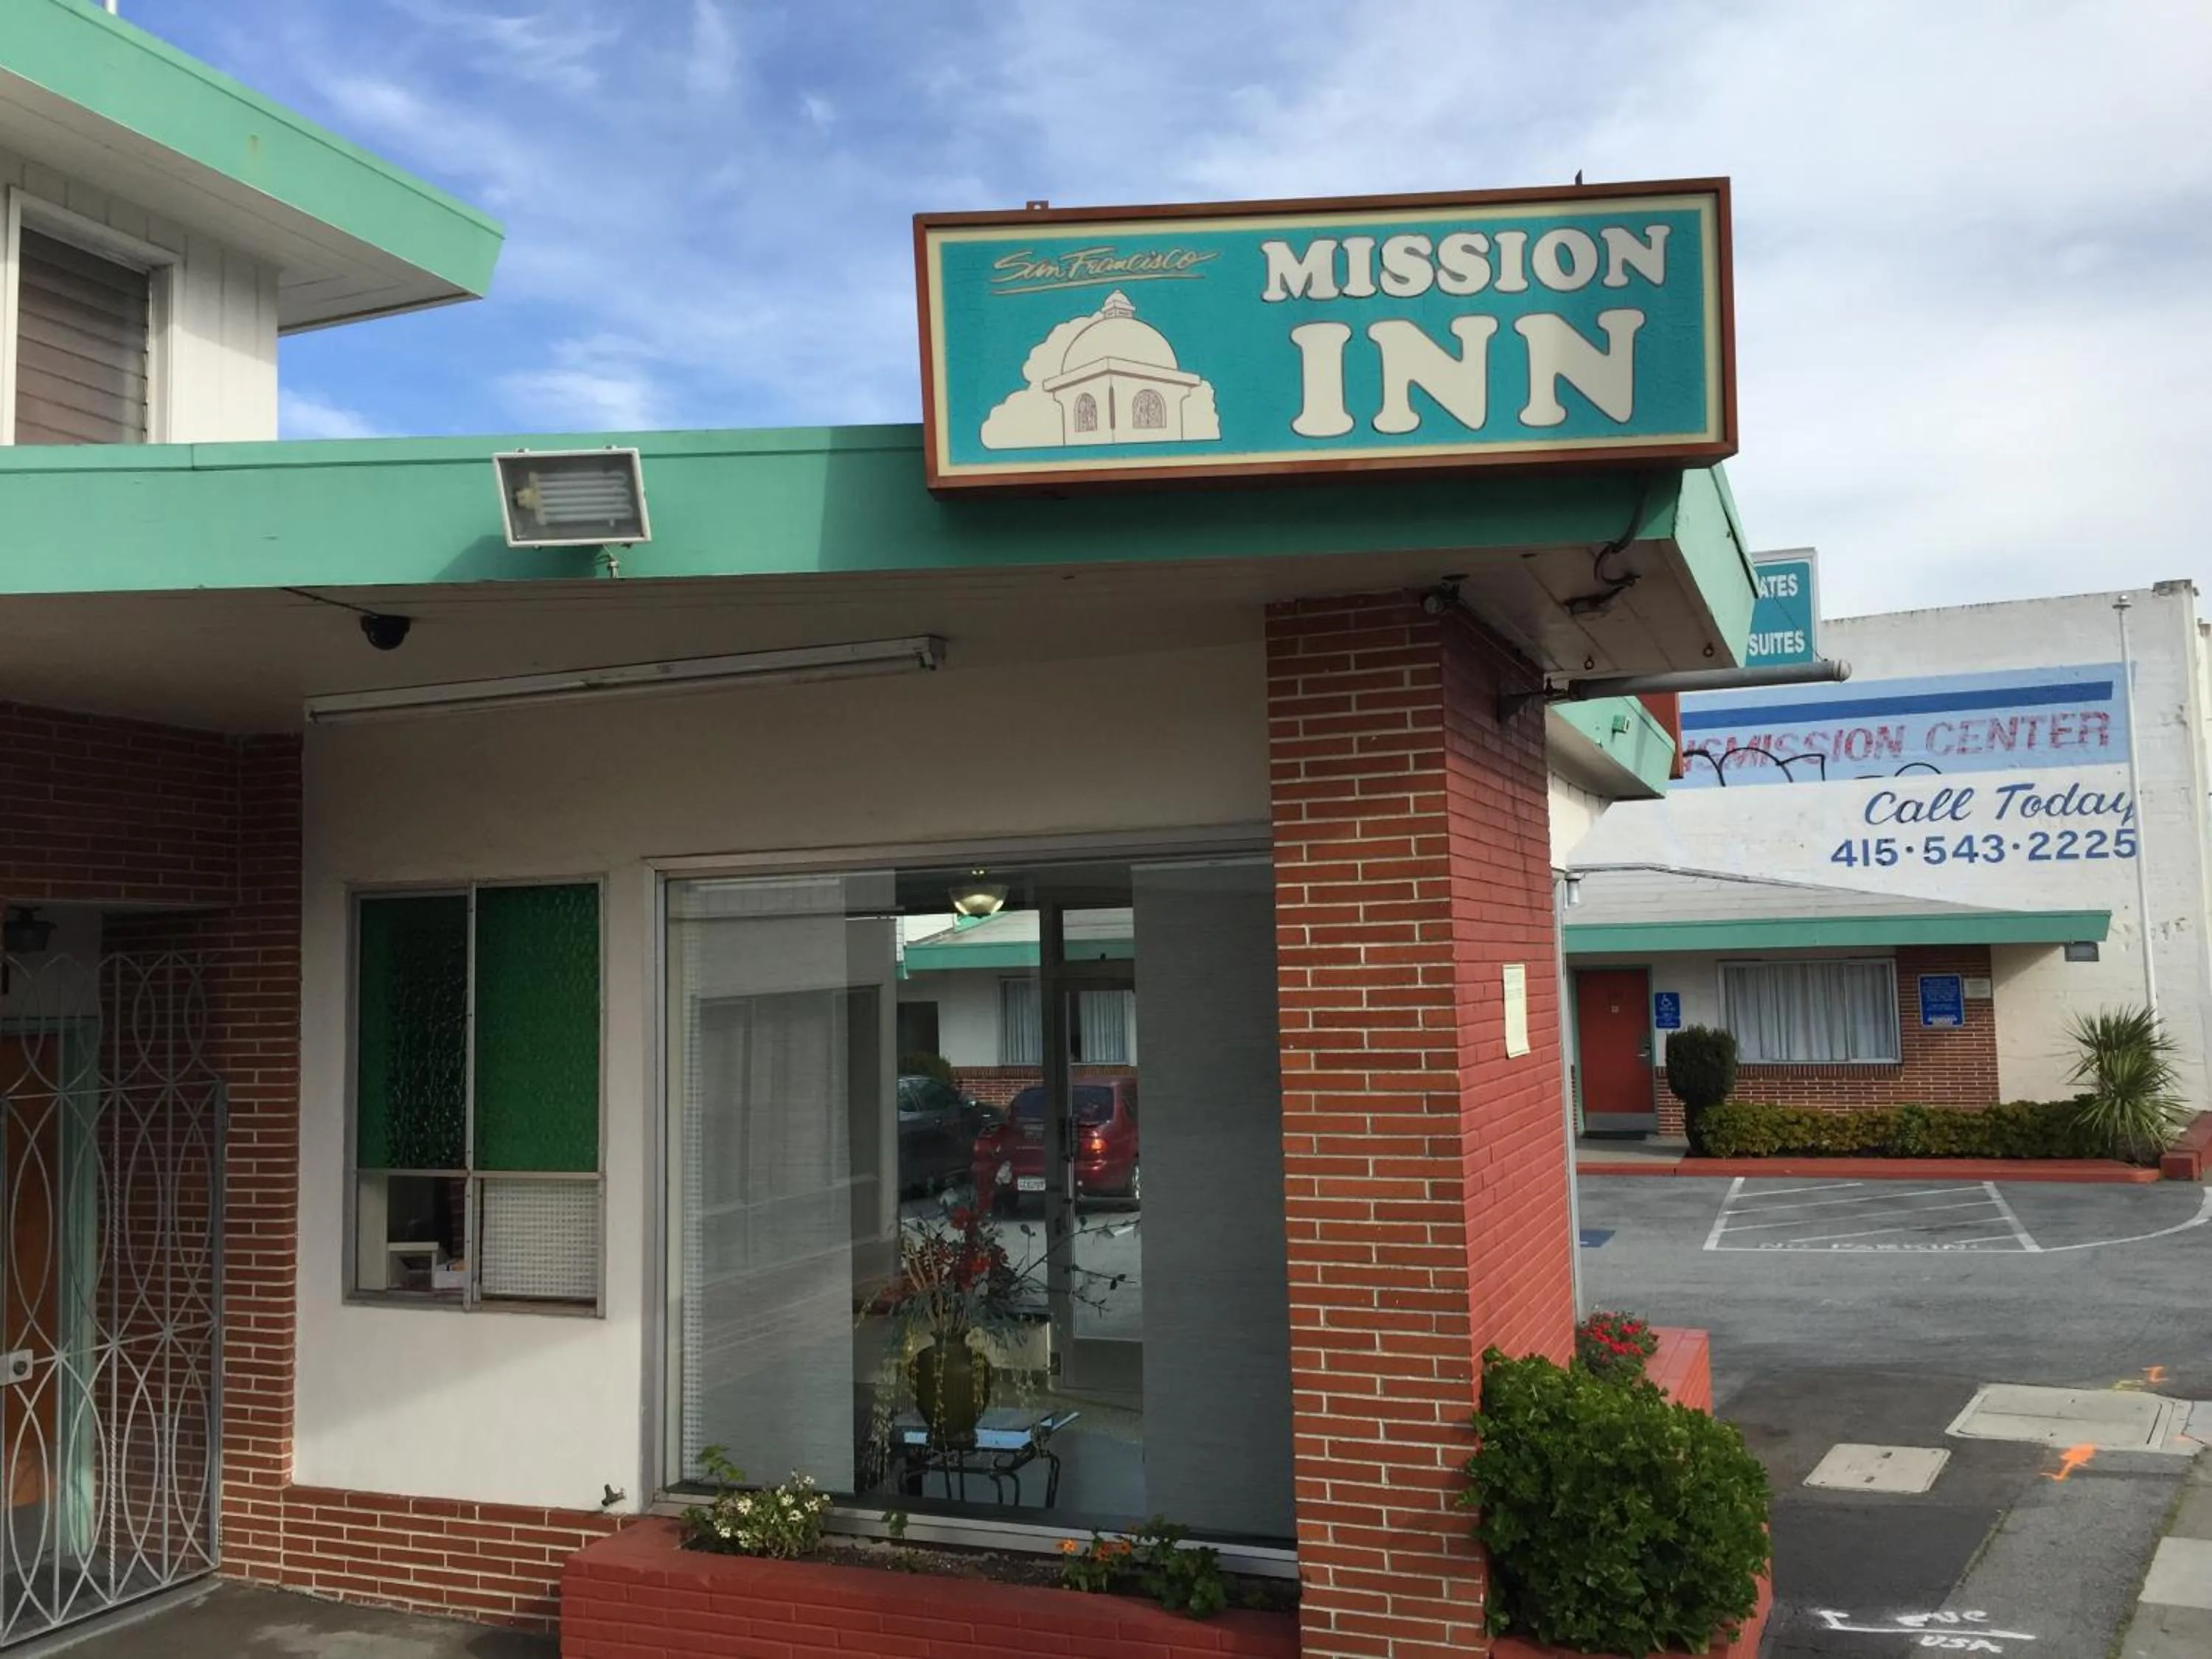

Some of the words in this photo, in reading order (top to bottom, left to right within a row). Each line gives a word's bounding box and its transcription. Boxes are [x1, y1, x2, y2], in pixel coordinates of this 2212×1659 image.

[990, 249, 1064, 282] San
[1262, 224, 1672, 303] MISSION
[1290, 308, 1646, 439] INN
[1748, 629, 1806, 655] SUITES
[1925, 710, 2110, 756] CENTER
[1864, 787, 1975, 825] Call
[1994, 782, 2135, 827] Today
